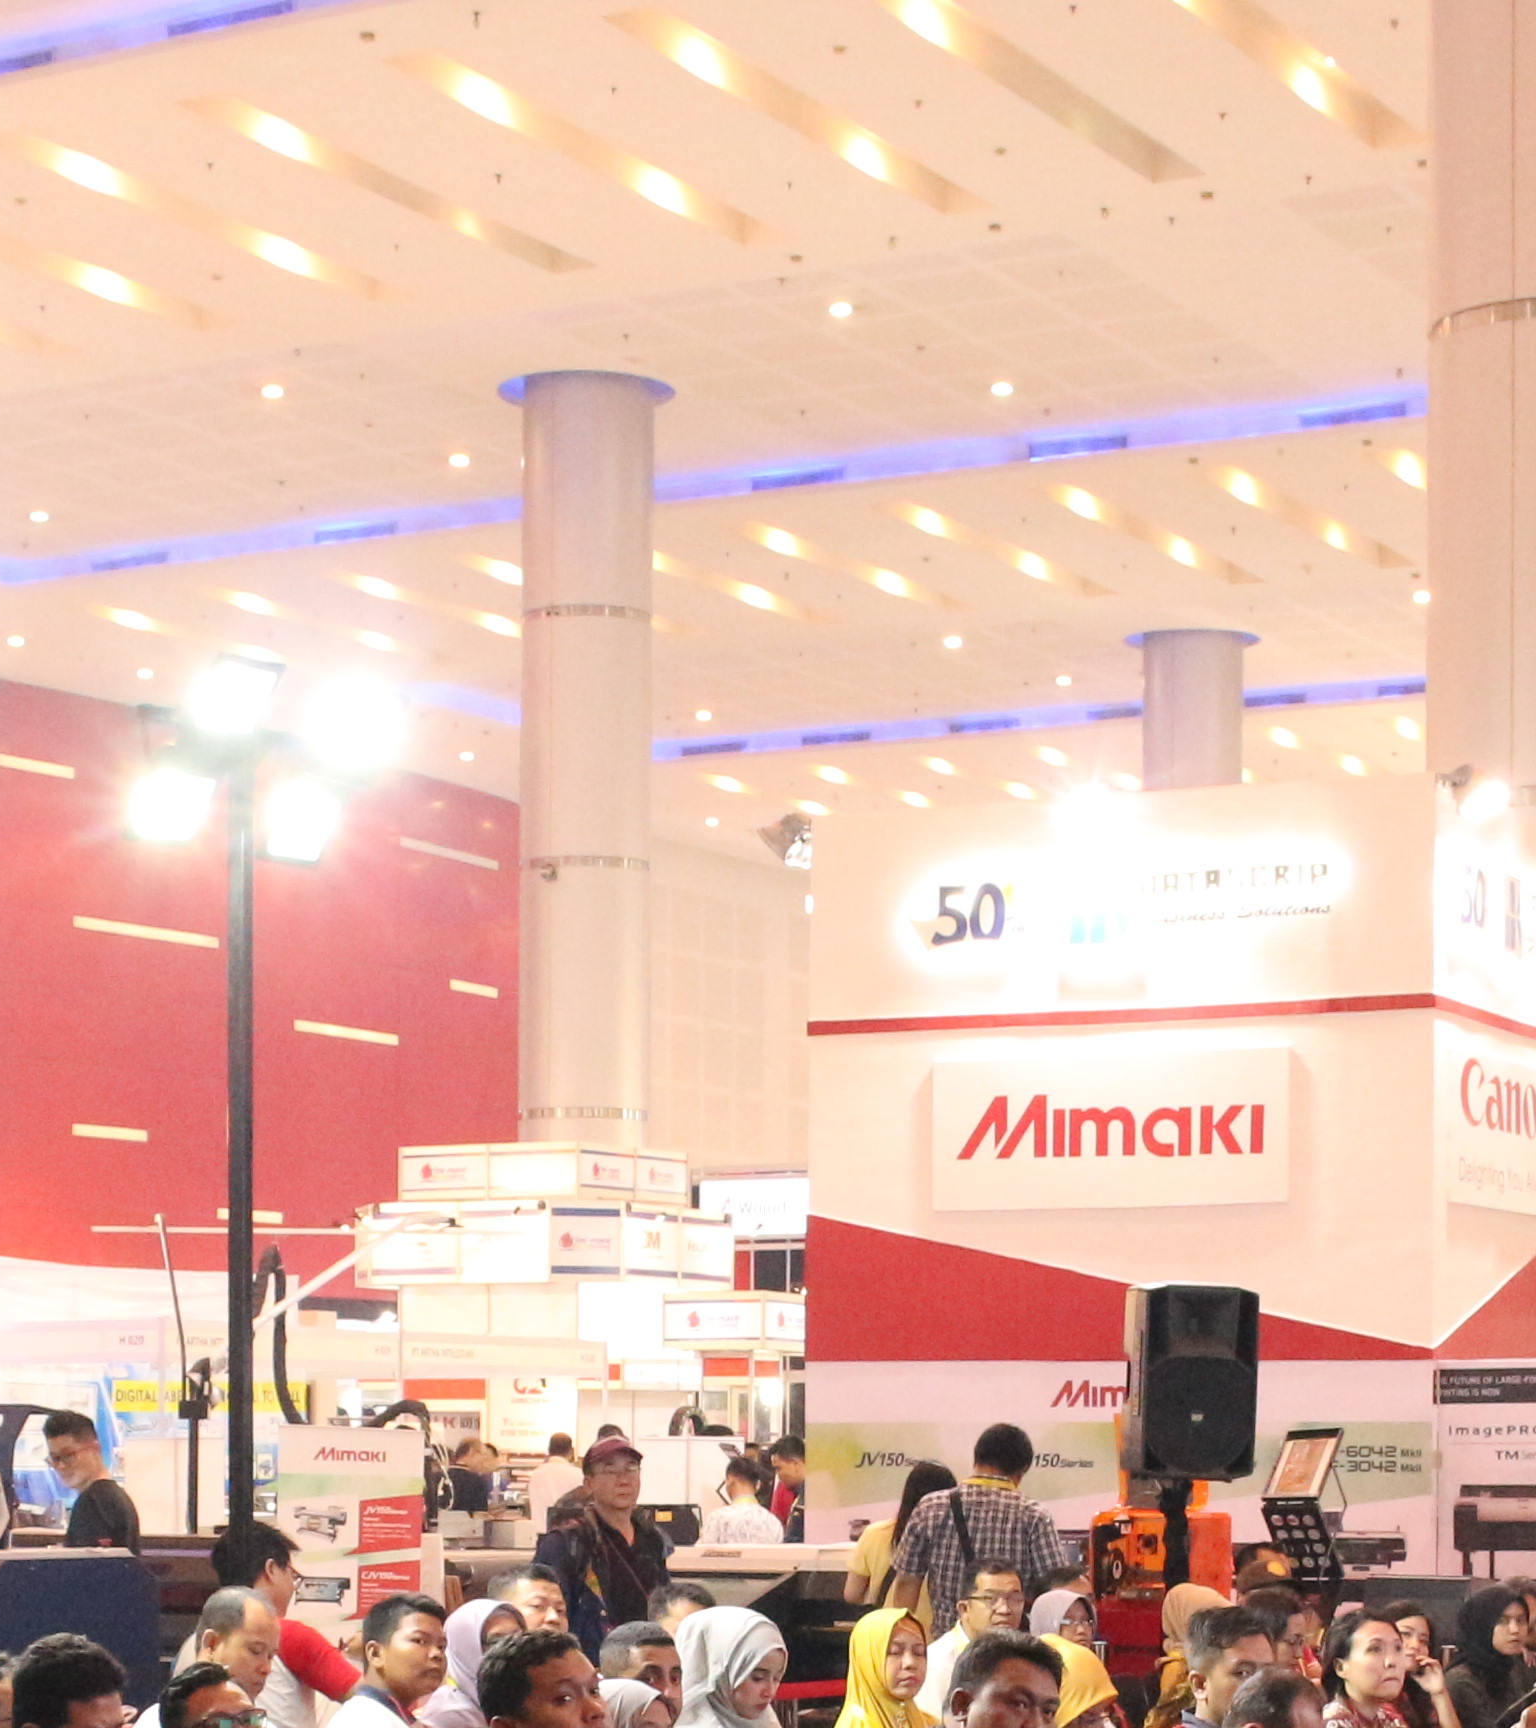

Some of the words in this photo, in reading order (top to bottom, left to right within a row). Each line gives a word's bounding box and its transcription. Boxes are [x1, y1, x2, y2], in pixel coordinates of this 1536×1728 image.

[931, 882, 1006, 947] 50
[1449, 1376, 1481, 1385] FUTURE
[1482, 1376, 1493, 1384] OF
[115, 1389, 158, 1403] DIGITAL
[1050, 1379, 1130, 1408] Mim
[1481, 1388, 1501, 1396] NOW
[1495, 1450, 1519, 1461] TM
